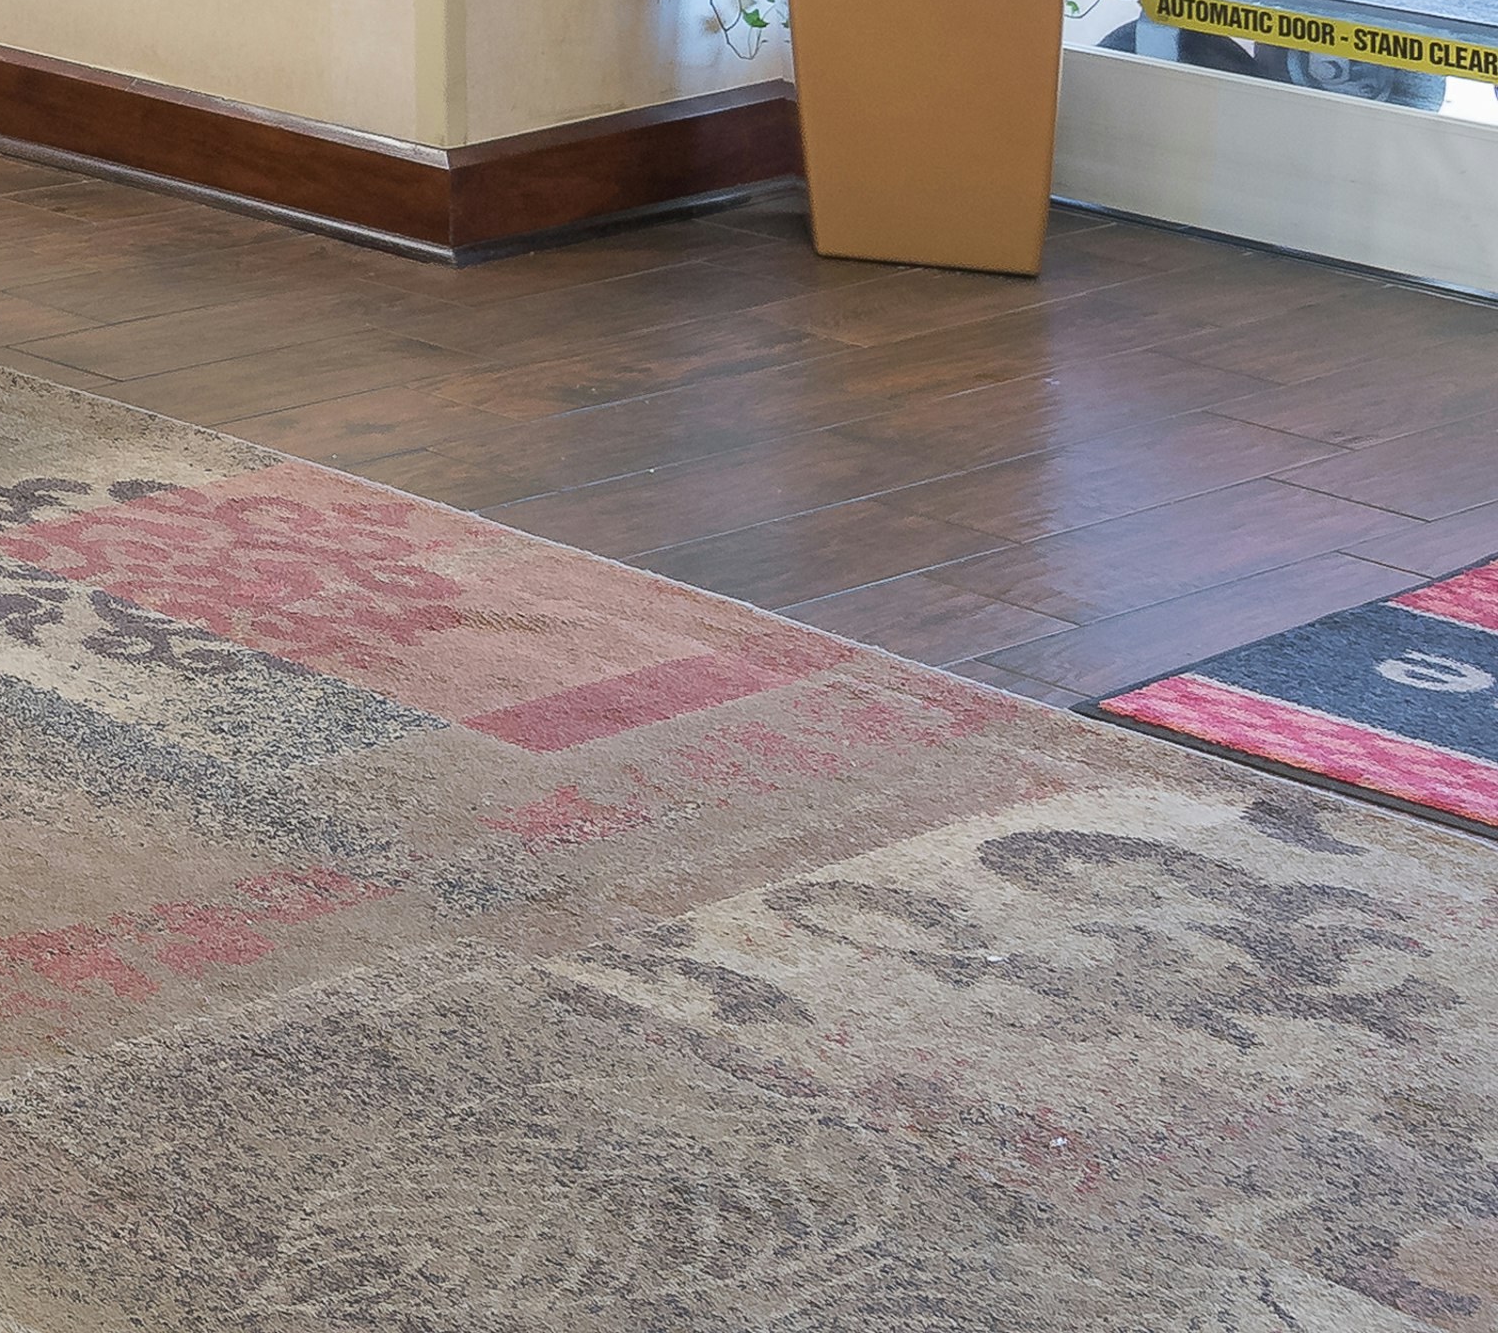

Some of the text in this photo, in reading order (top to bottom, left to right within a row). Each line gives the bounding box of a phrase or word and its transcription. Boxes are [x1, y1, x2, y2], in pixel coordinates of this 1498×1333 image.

[1277, 15, 1336, 46] DOOR
[1353, 27, 1424, 62] STAND
[1428, 41, 1498, 76] CLEAR
